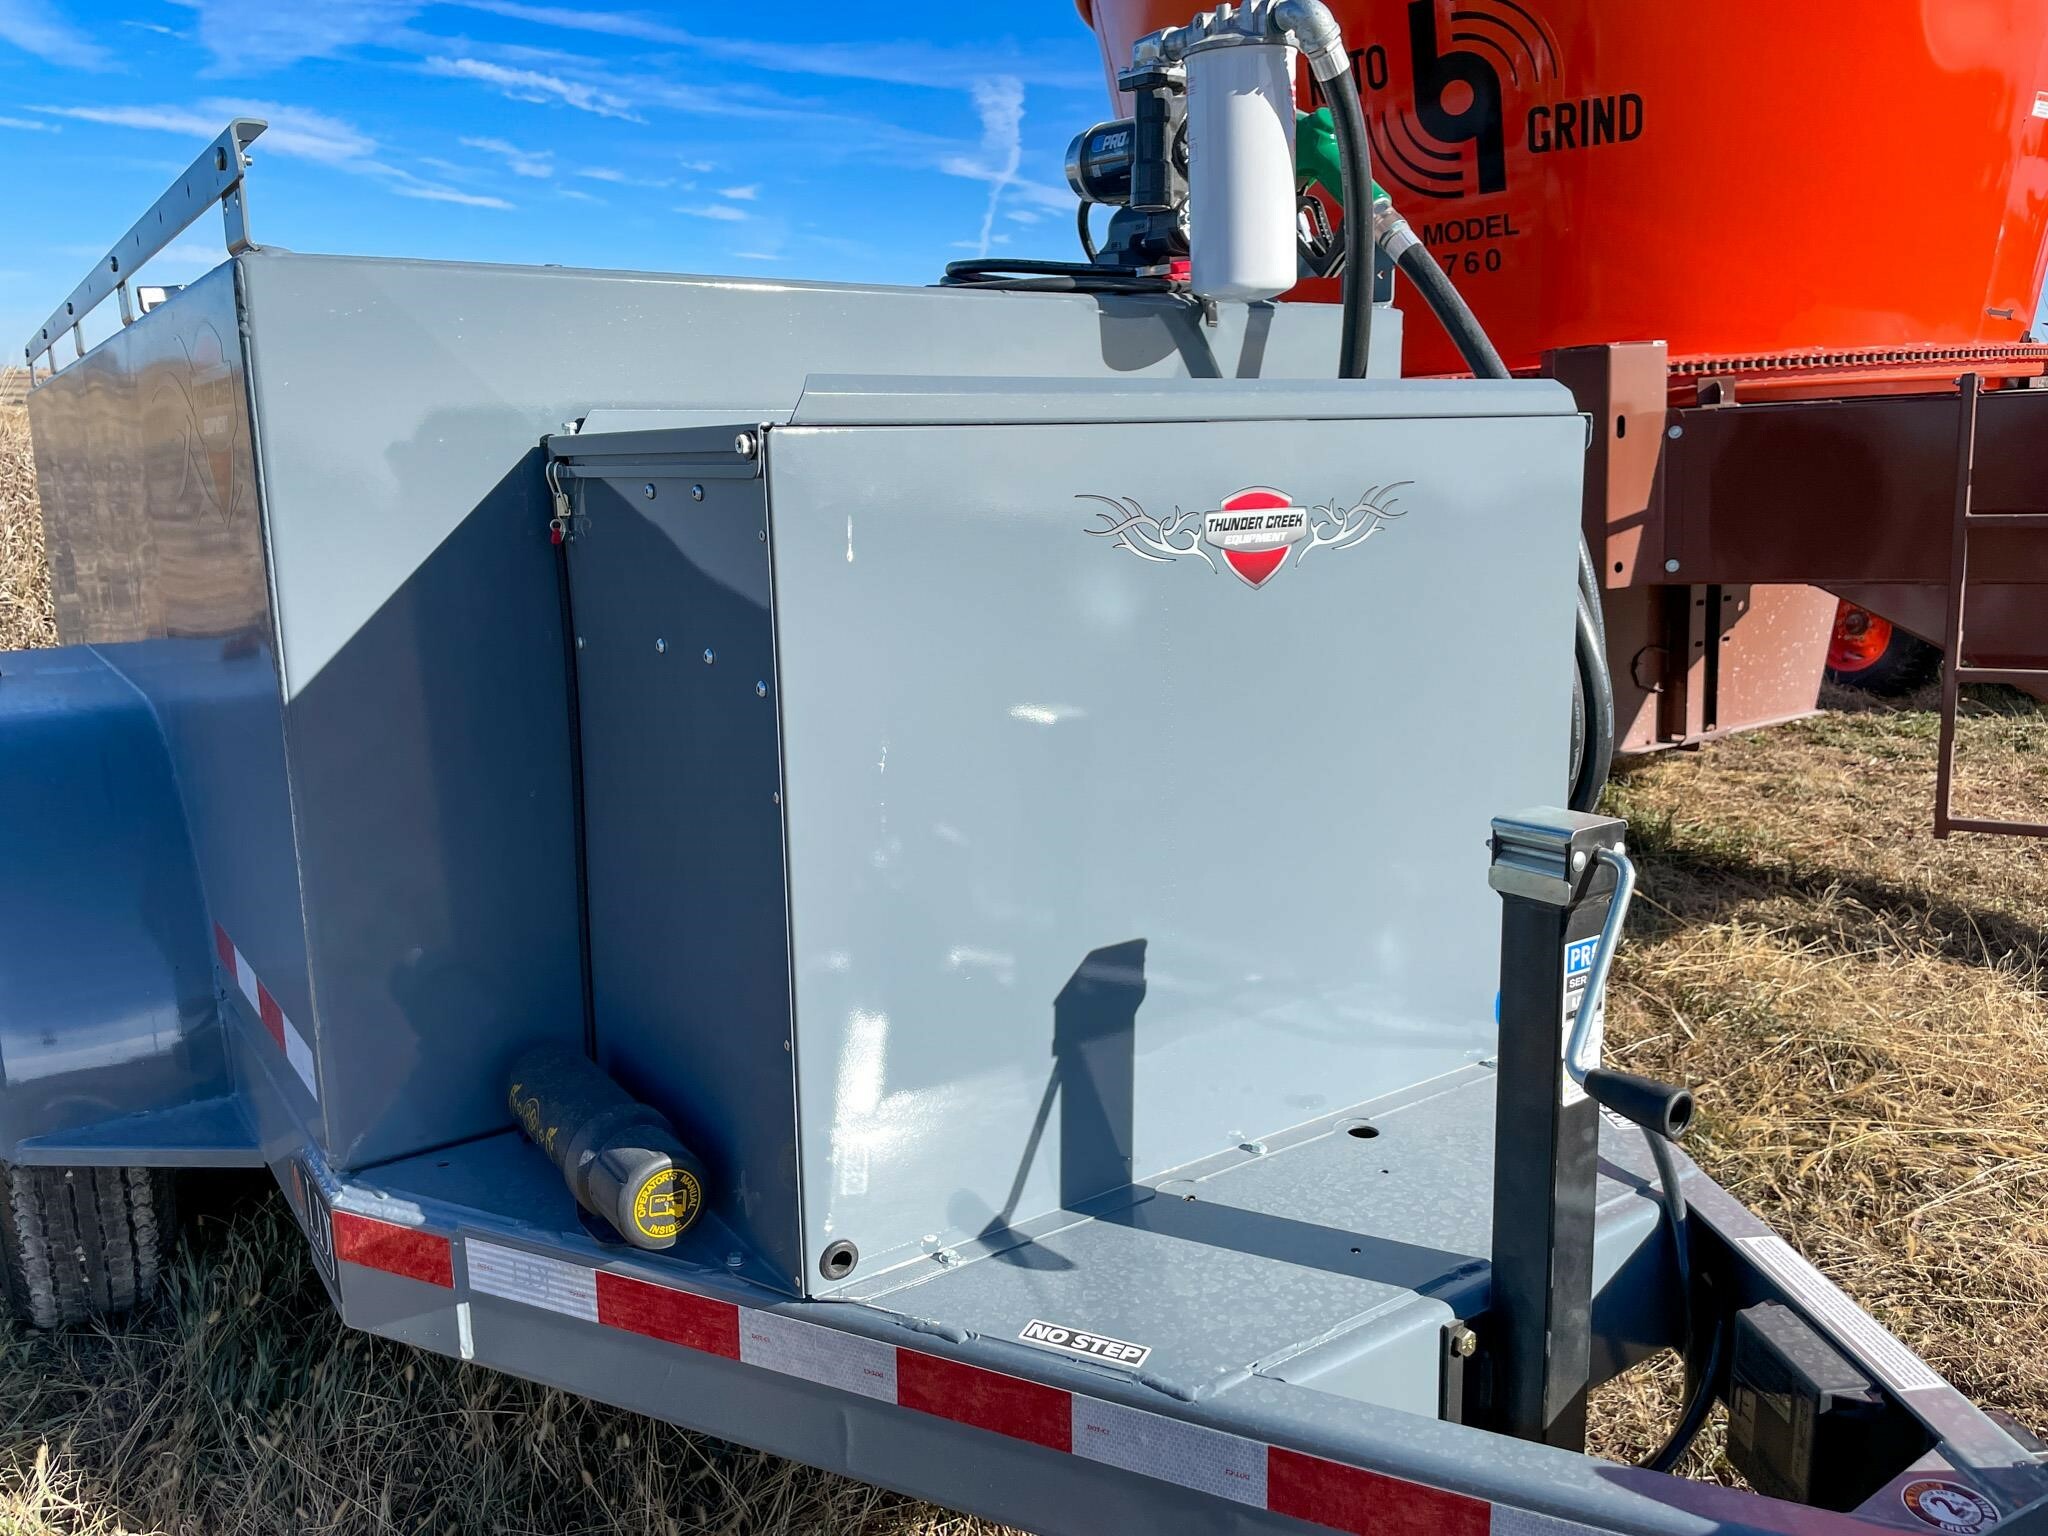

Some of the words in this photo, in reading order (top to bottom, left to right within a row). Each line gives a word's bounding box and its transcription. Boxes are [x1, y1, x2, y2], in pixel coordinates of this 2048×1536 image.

[1527, 93, 1643, 153] GRIND
[1422, 213, 1520, 247] MODEL
[1443, 248, 1501, 277] 760
[1208, 516, 1263, 532] THUNDER
[1265, 514, 1304, 529] CREEK
[1224, 531, 1288, 545] EQUIPMENT
[1569, 975, 1588, 988] SER
[637, 1172, 678, 1218] OPERATOR'S
[680, 1174, 699, 1210] MANUAL
[649, 1220, 682, 1235] INSIDE
[1026, 1323, 1069, 1343] NO
[1070, 1335, 1143, 1360] STEP
